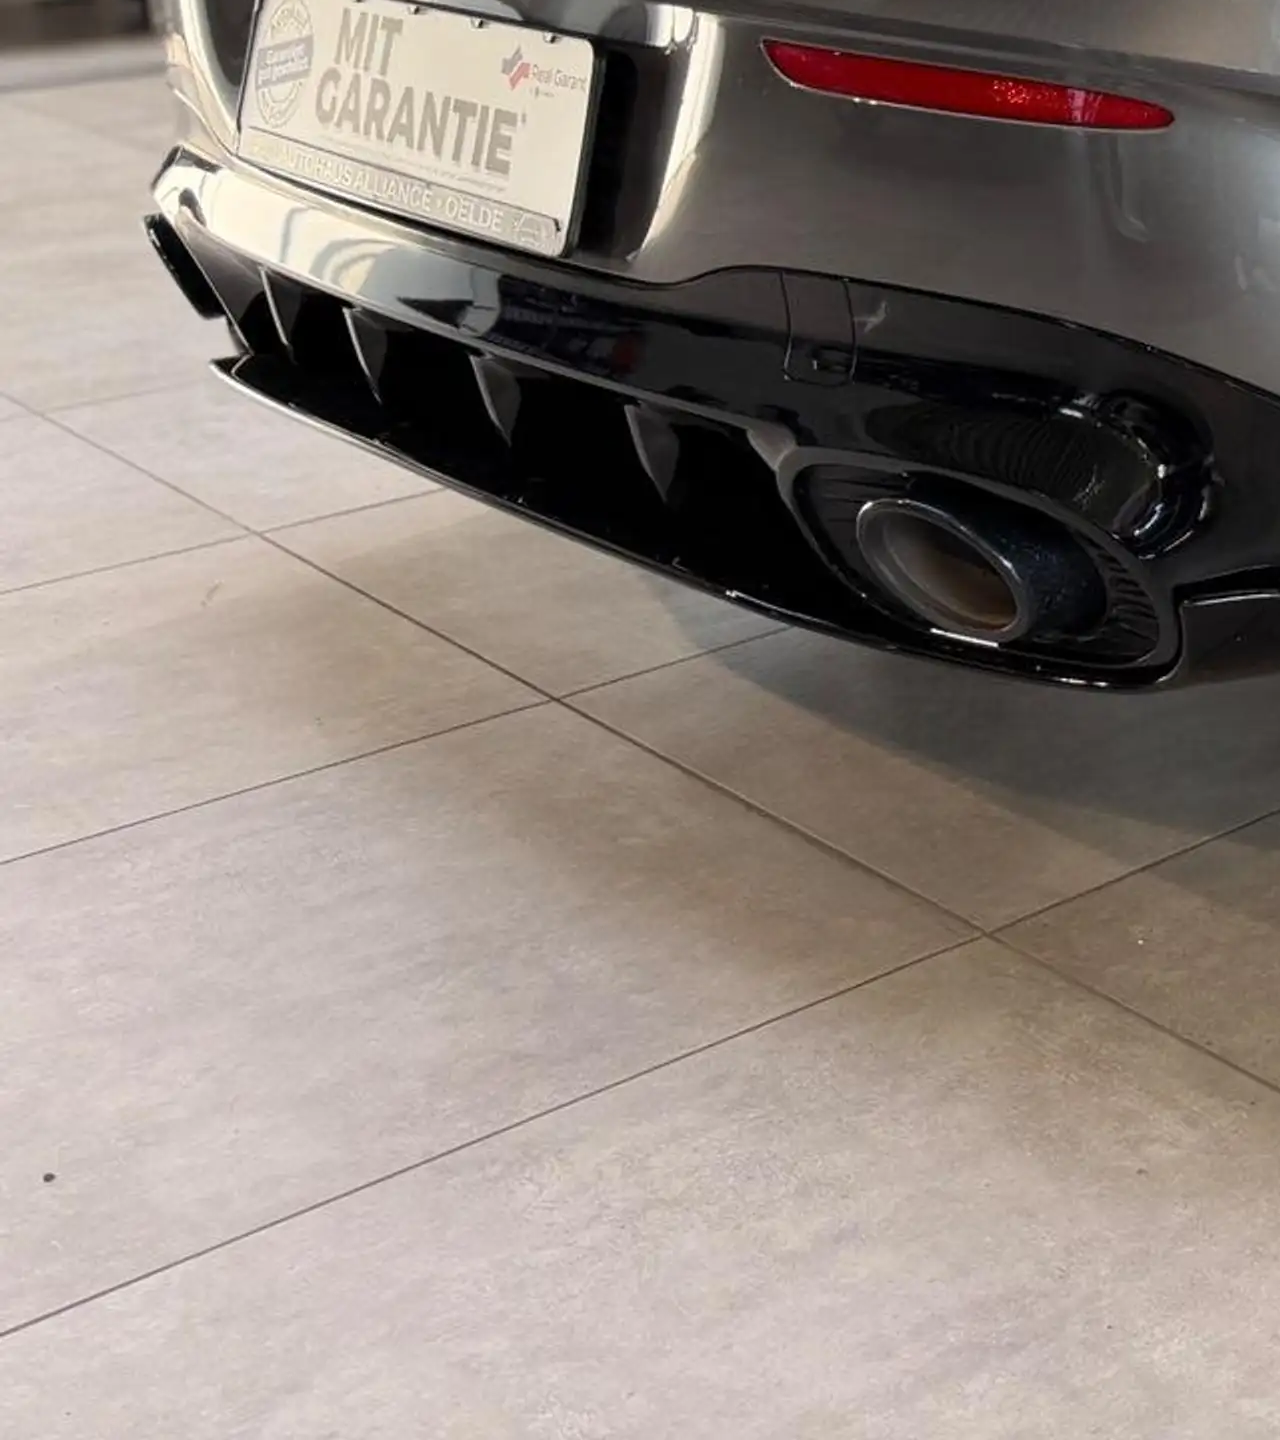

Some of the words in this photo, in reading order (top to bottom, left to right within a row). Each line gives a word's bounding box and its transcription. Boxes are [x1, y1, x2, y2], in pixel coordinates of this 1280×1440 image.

[335, 7, 403, 76] MIT
[315, 67, 516, 175] GARANTIE
[280, 143, 352, 186] AUTOHAUS
[352, 167, 433, 210] ALLIANCE
[445, 196, 504, 232] OELDE
